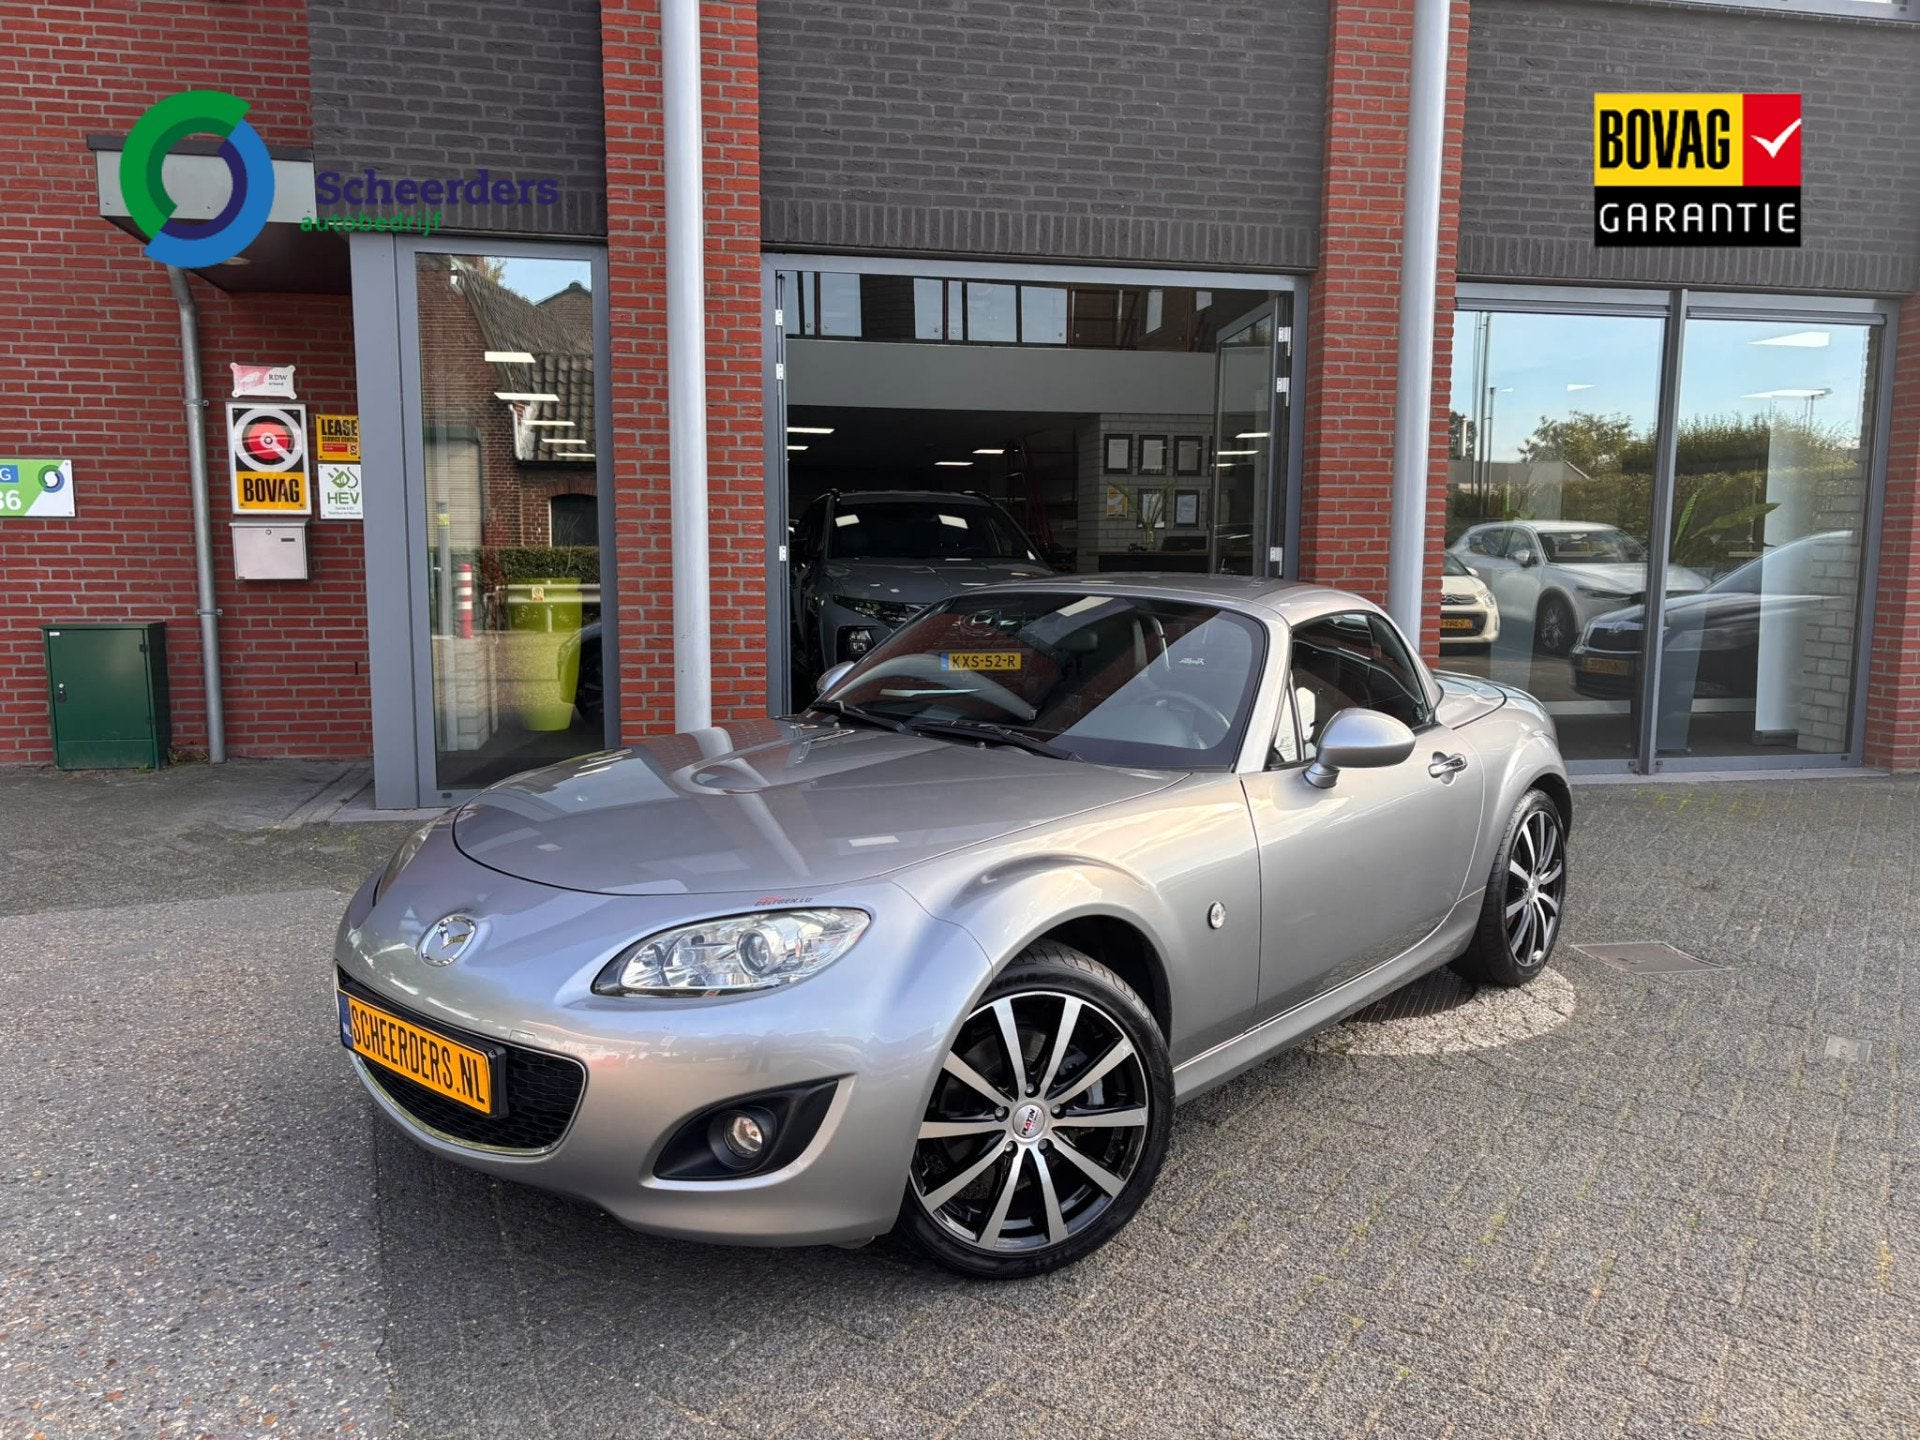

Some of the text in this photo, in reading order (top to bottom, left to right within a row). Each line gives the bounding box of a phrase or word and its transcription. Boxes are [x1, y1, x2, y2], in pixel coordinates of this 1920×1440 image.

[268, 373, 288, 381] RDW
[321, 419, 358, 436] LEASE
[243, 478, 300, 502] BOVAG
[327, 491, 360, 505] HEV
[952, 655, 1016, 668] KXS-52-R
[351, 1005, 486, 1104] SCHEERDERS.NL
